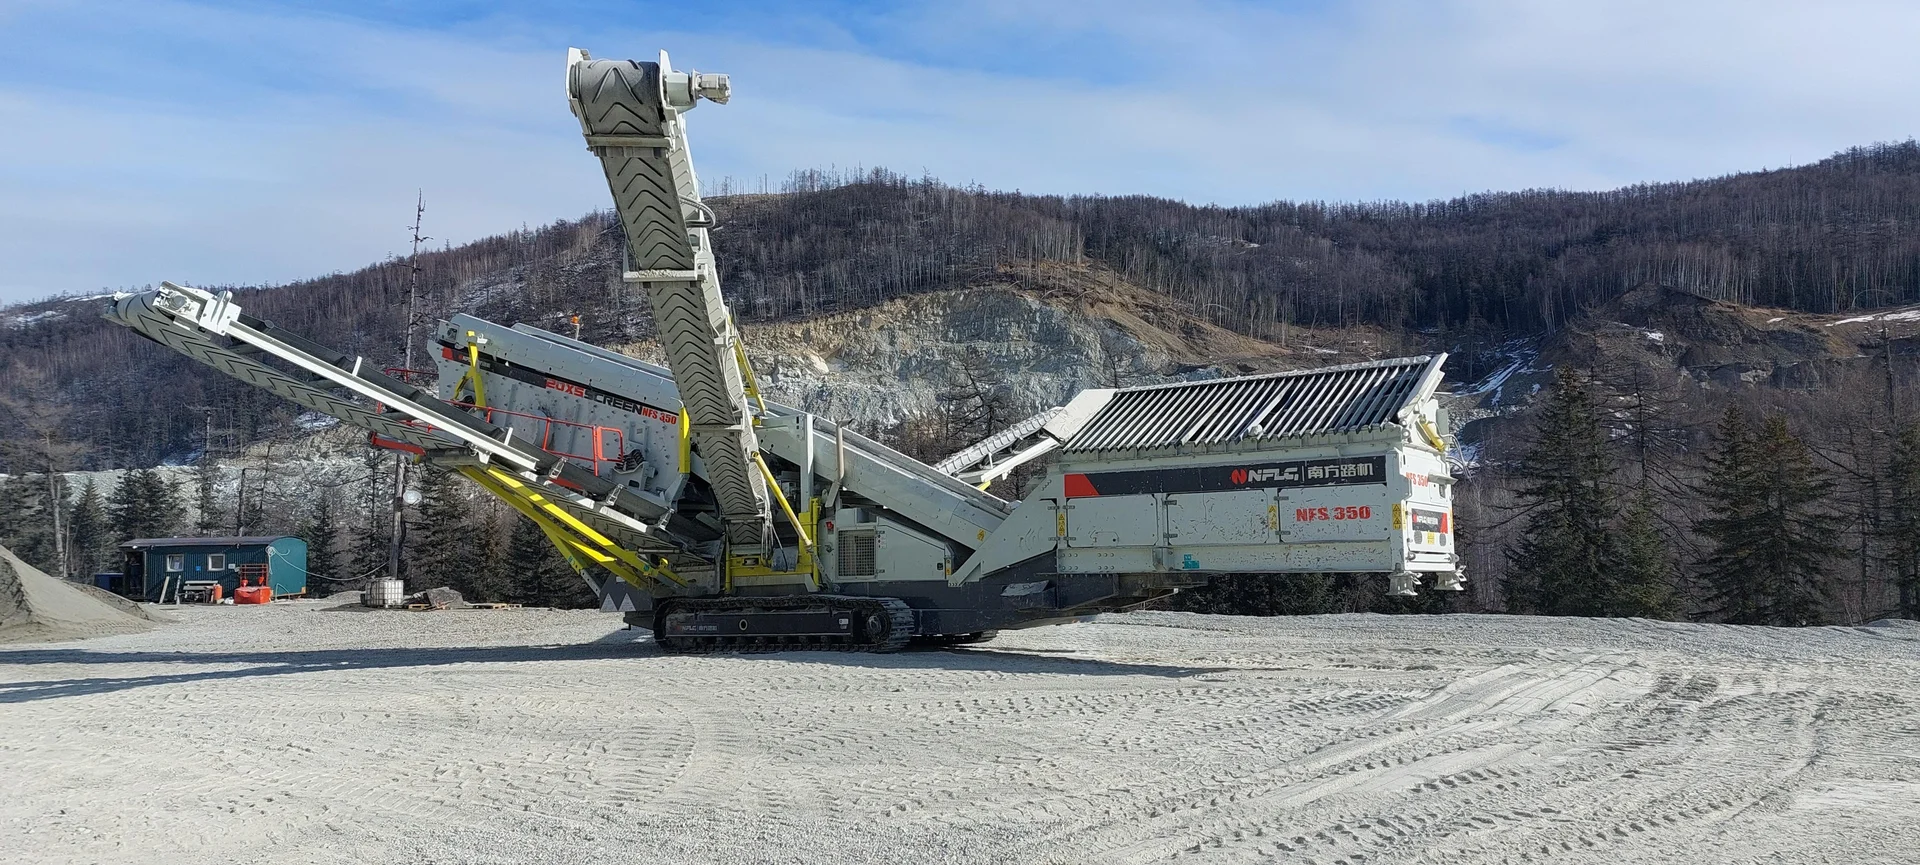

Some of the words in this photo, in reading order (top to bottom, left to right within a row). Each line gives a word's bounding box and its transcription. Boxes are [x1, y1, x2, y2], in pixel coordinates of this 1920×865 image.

[642, 407, 658, 419] NFS
[659, 412, 677, 425] 350
[1307, 463, 1374, 479] 南方路机
[1296, 507, 1329, 522] NFS
[1334, 506, 1371, 520] 350
